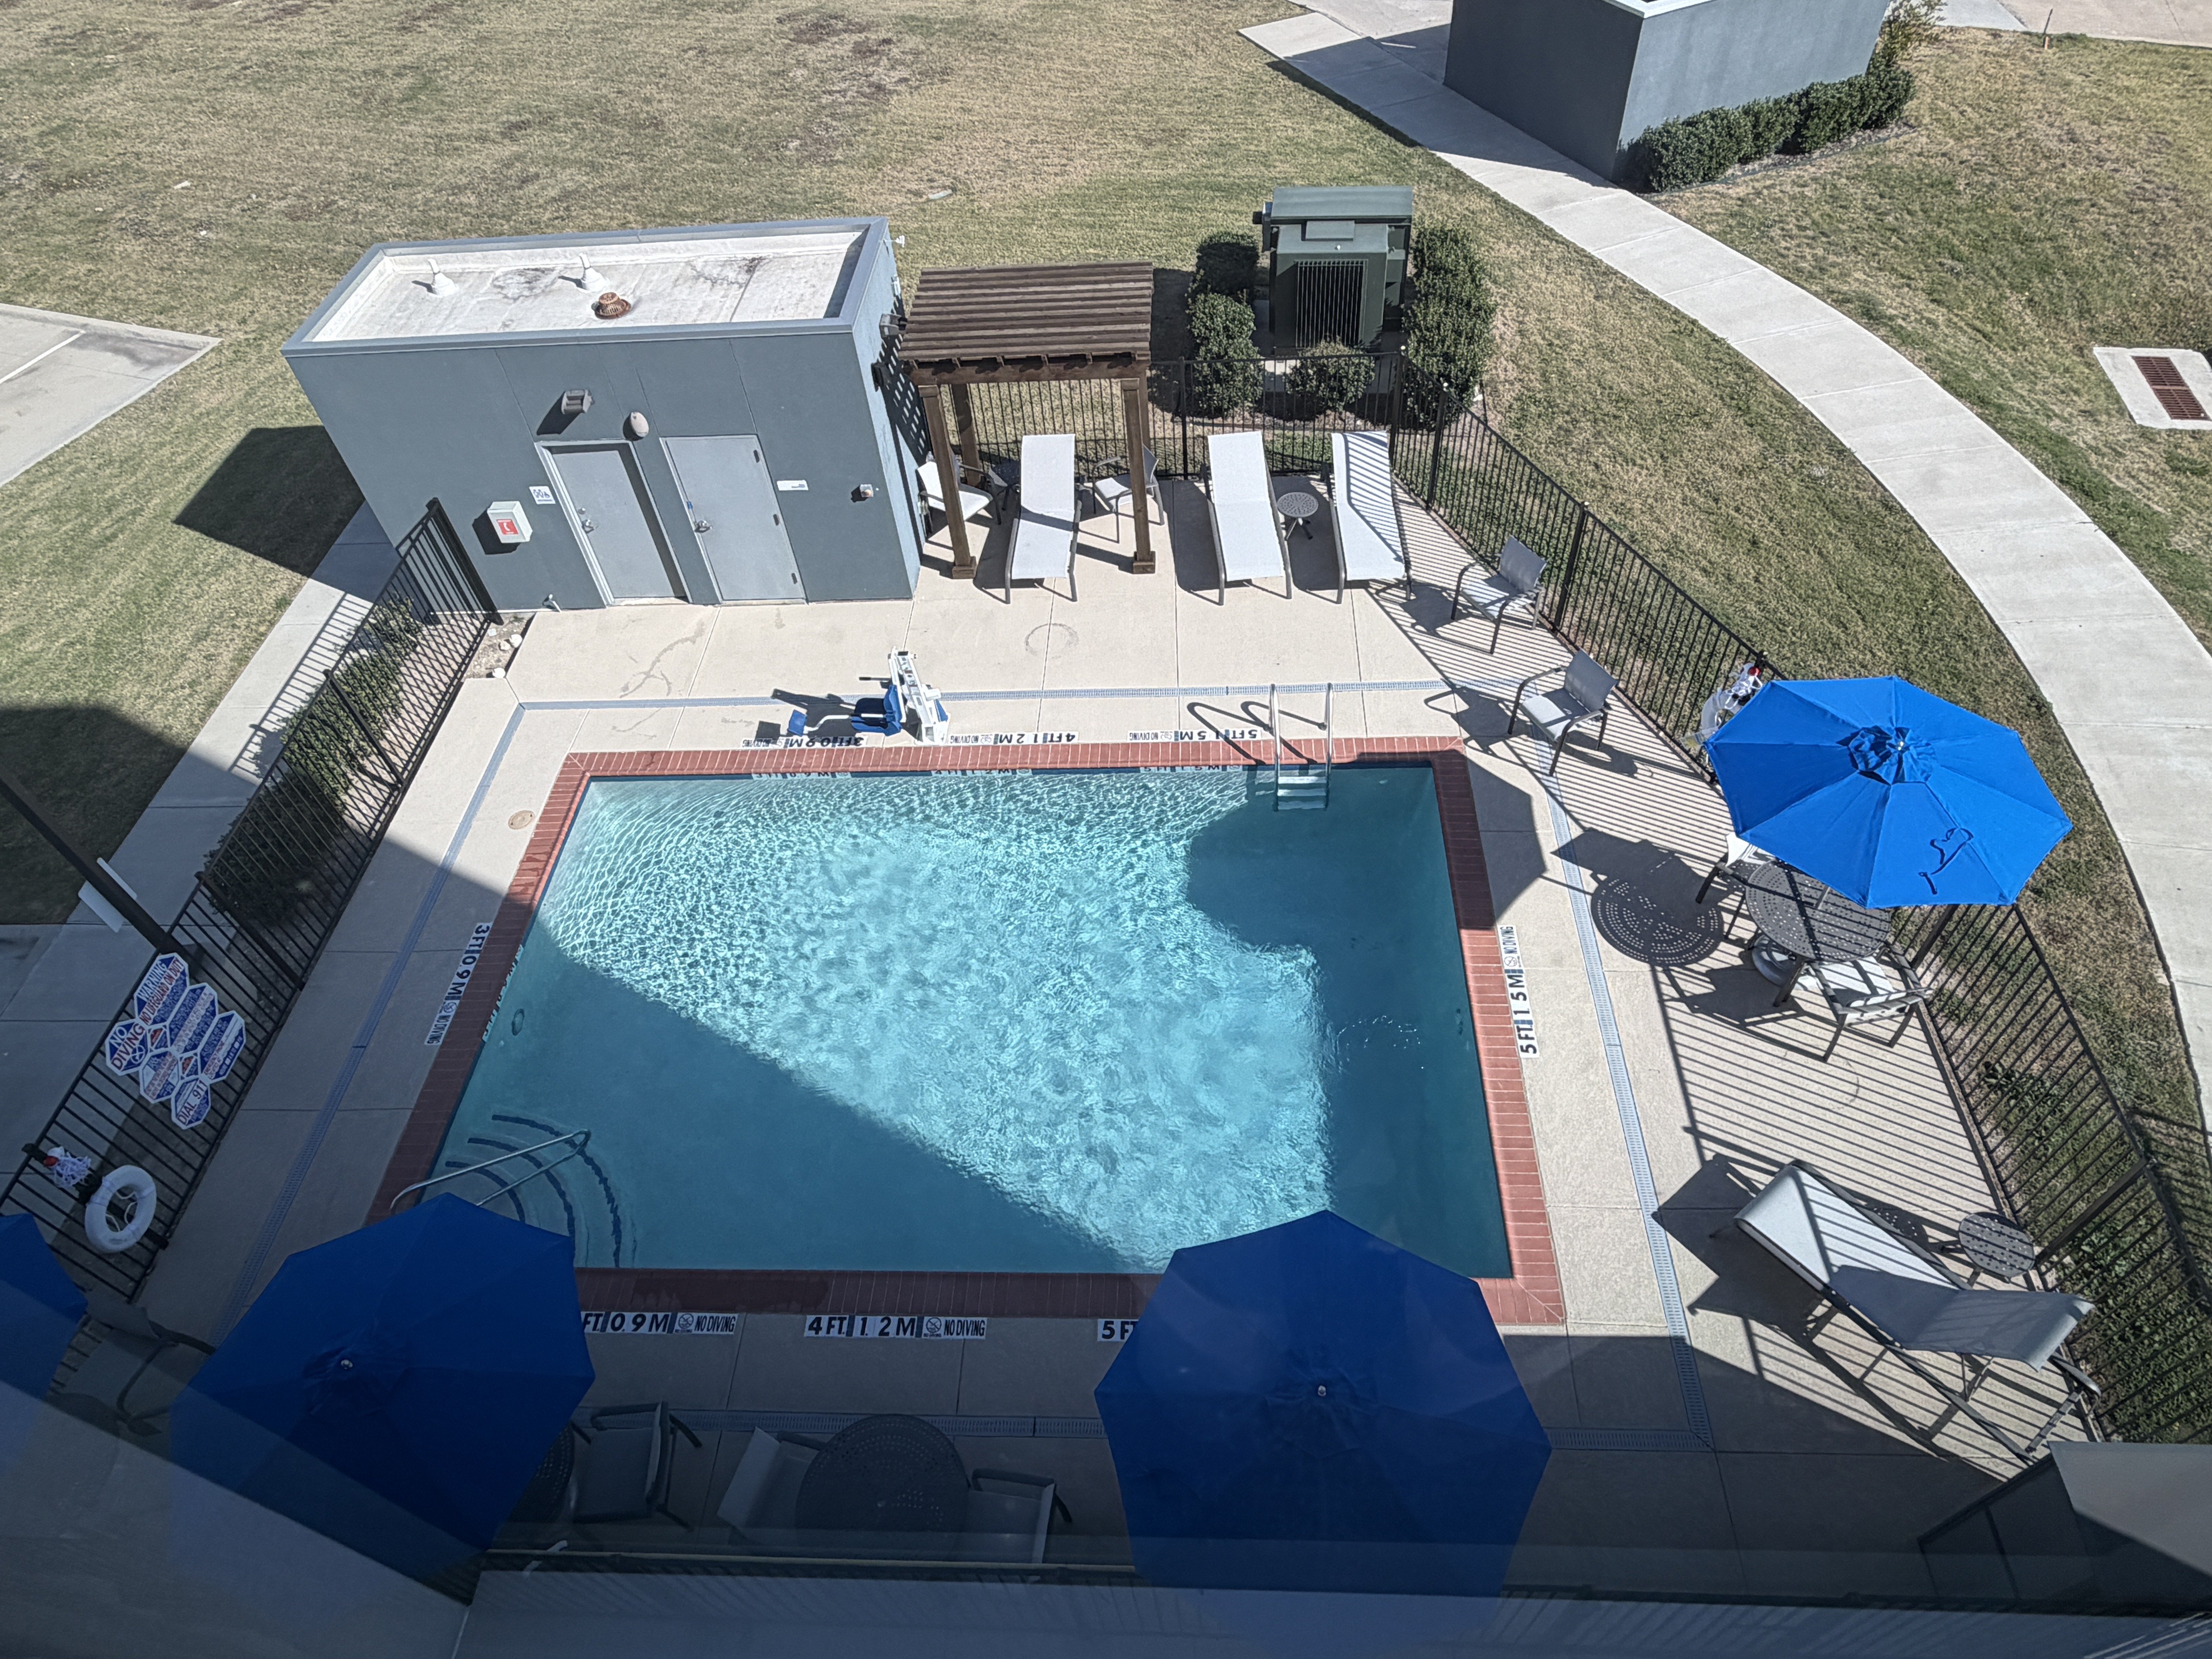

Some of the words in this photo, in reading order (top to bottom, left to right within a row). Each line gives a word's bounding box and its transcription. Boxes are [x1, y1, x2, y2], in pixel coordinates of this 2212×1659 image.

[999, 734, 1013, 744] M
[1065, 733, 1076, 742] 4
[1129, 732, 1150, 741] DIVING
[1151, 732, 1158, 740] NO
[1180, 731, 1193, 740] M
[1248, 730, 1257, 739] 5
[789, 738, 803, 747] M
[854, 737, 864, 747] 3
[475, 925, 490, 934] 3
[1499, 926, 1516, 945] DIVING
[137, 960, 167, 1002] WARNING
[1507, 974, 1525, 988] M
[139, 1012, 152, 1026] NO
[147, 982, 170, 1015] LIFEGUARD
[163, 972, 175, 986] ON
[169, 957, 184, 977] DUTY
[448, 982, 466, 995] M
[436, 1015, 451, 1023] NO
[109, 1026, 127, 1047] NO
[427, 1024, 447, 1044] DIVING
[111, 1023, 145, 1070] DIVING
[1520, 1044, 1537, 1054] 5
[177, 1101, 197, 1125] DIAL
[192, 1079, 208, 1099] 911
[648, 1314, 670, 1333] M
[694, 1315, 706, 1332] NO
[706, 1315, 736, 1332] DIVING
[808, 1317, 823, 1335] 4
[895, 1317, 916, 1336] M
[943, 1319, 956, 1336] NO
[956, 1319, 986, 1337] DIVING
[1102, 1321, 1115, 1339] 5
